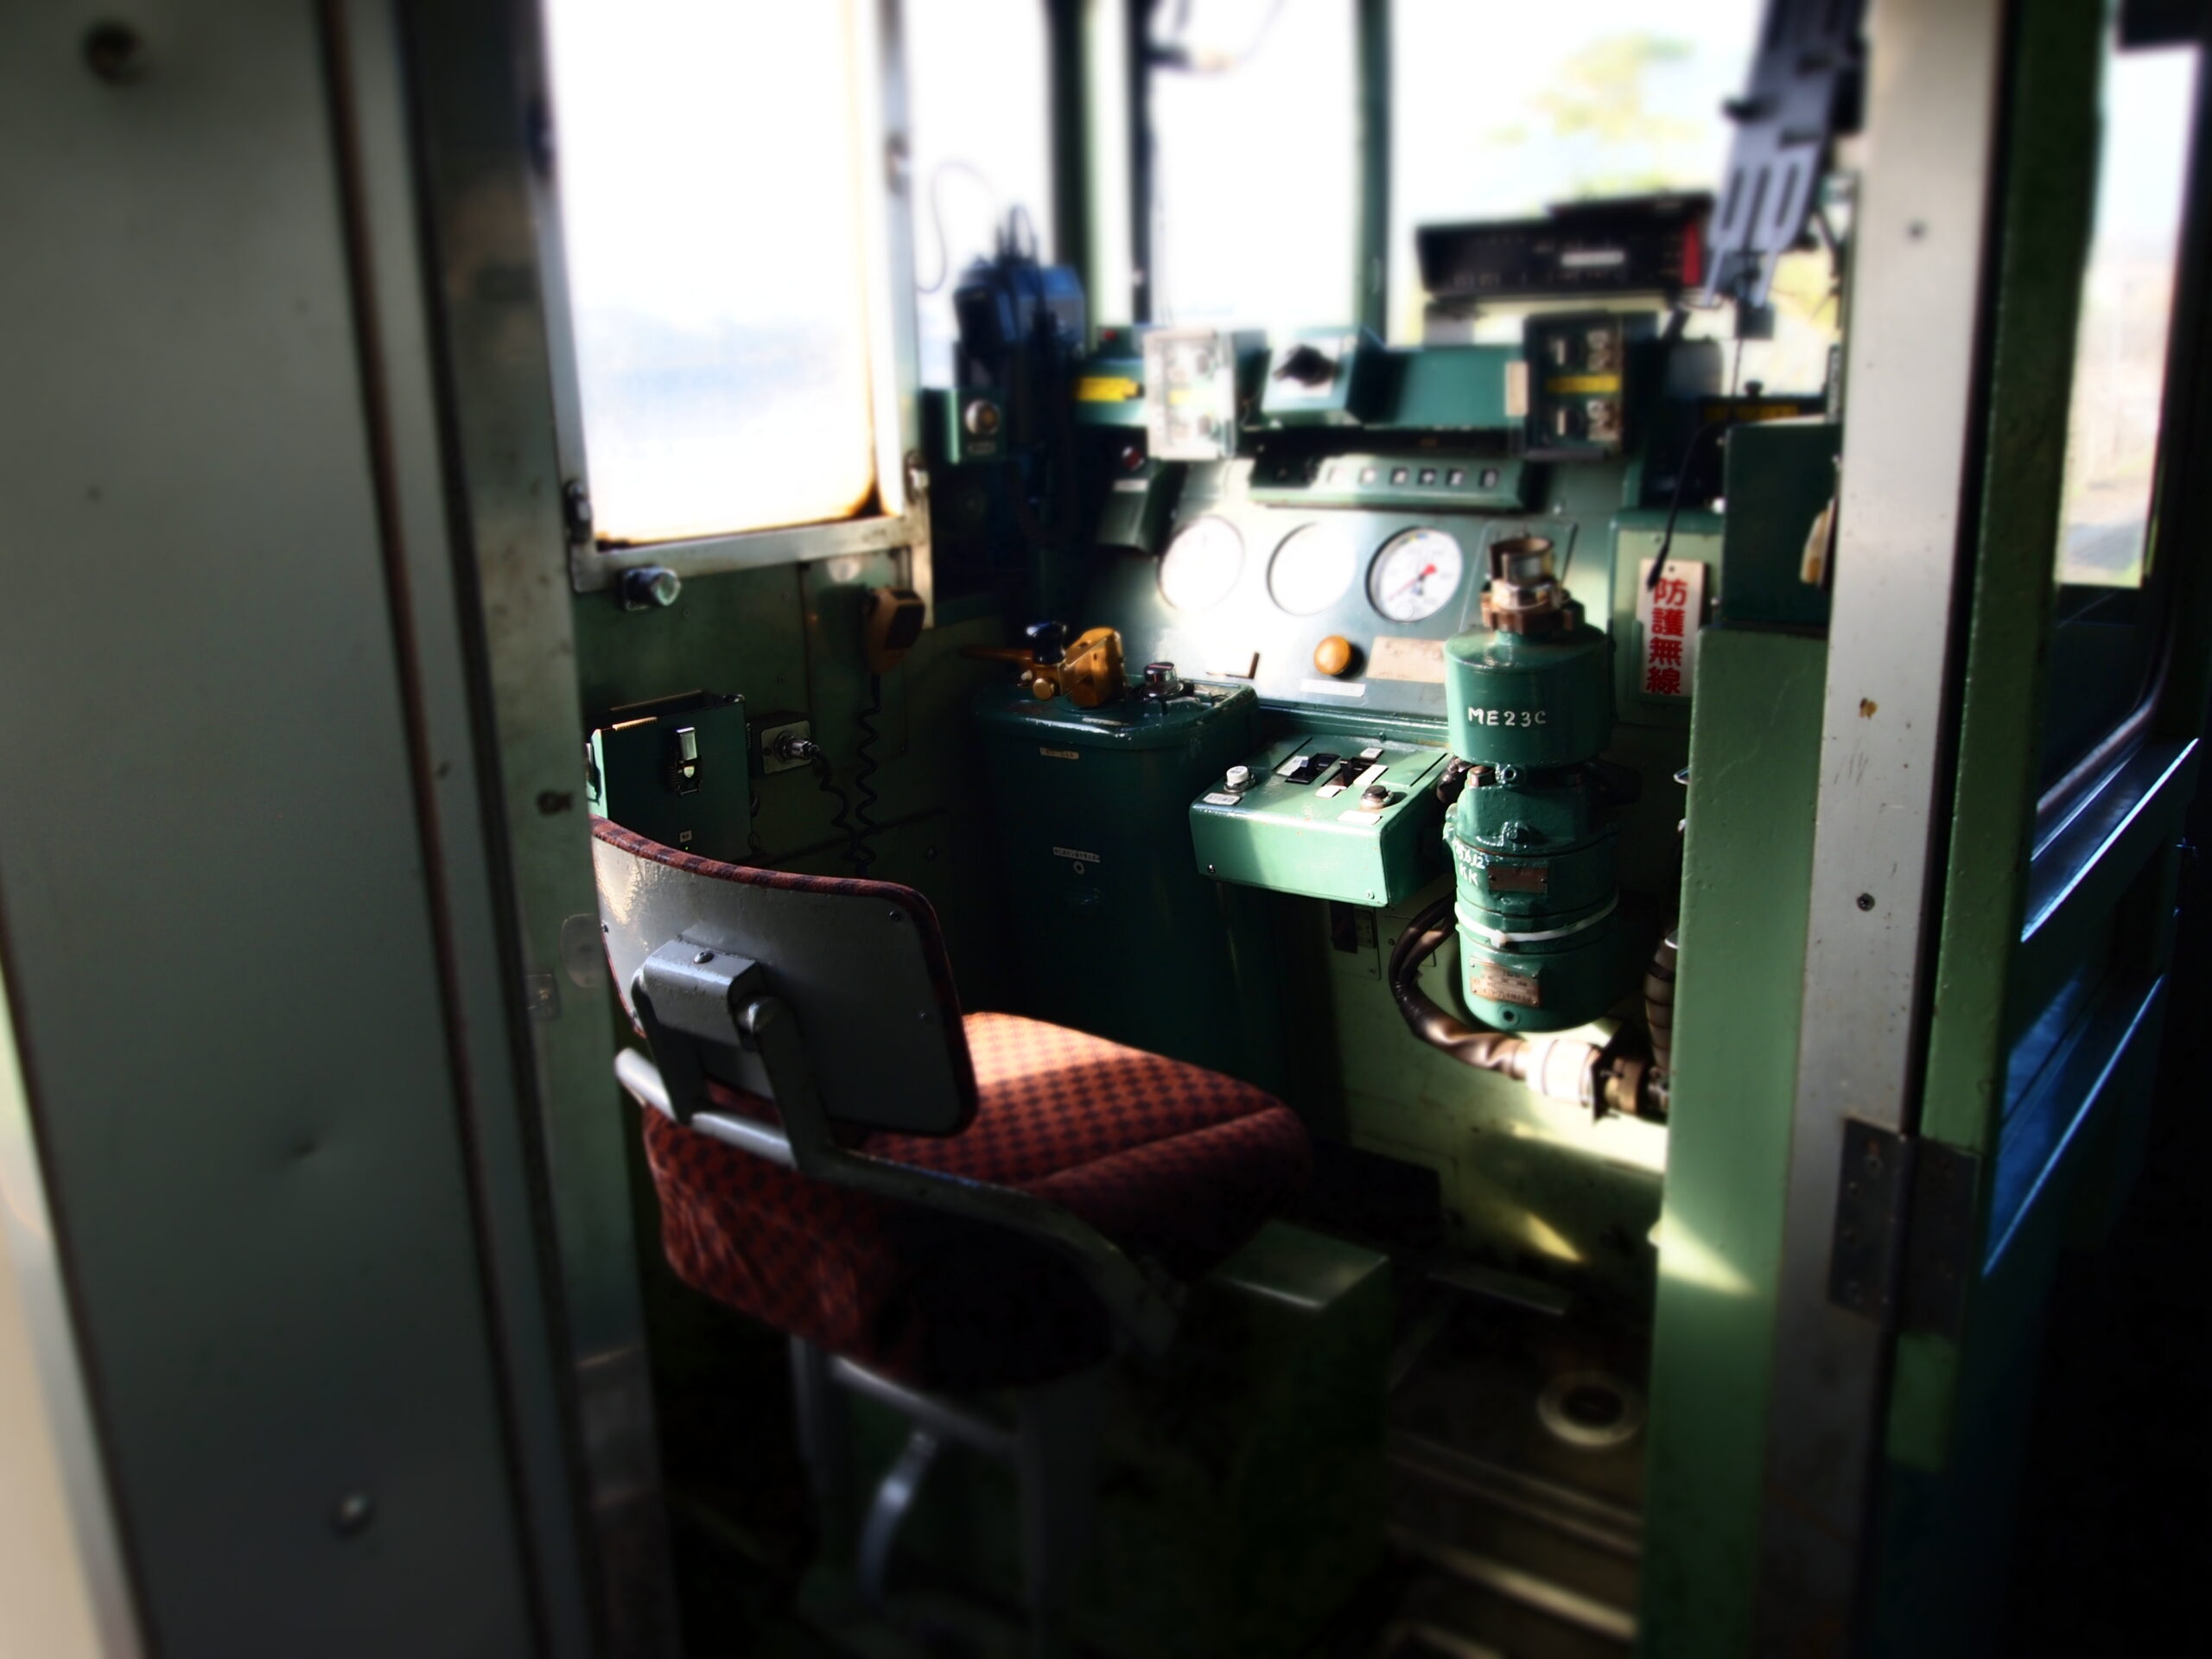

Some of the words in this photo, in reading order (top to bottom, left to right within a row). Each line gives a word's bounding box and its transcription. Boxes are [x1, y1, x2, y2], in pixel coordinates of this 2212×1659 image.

[1646, 577, 1688, 695] 防護無線
[1467, 707, 1547, 727] ME23C
